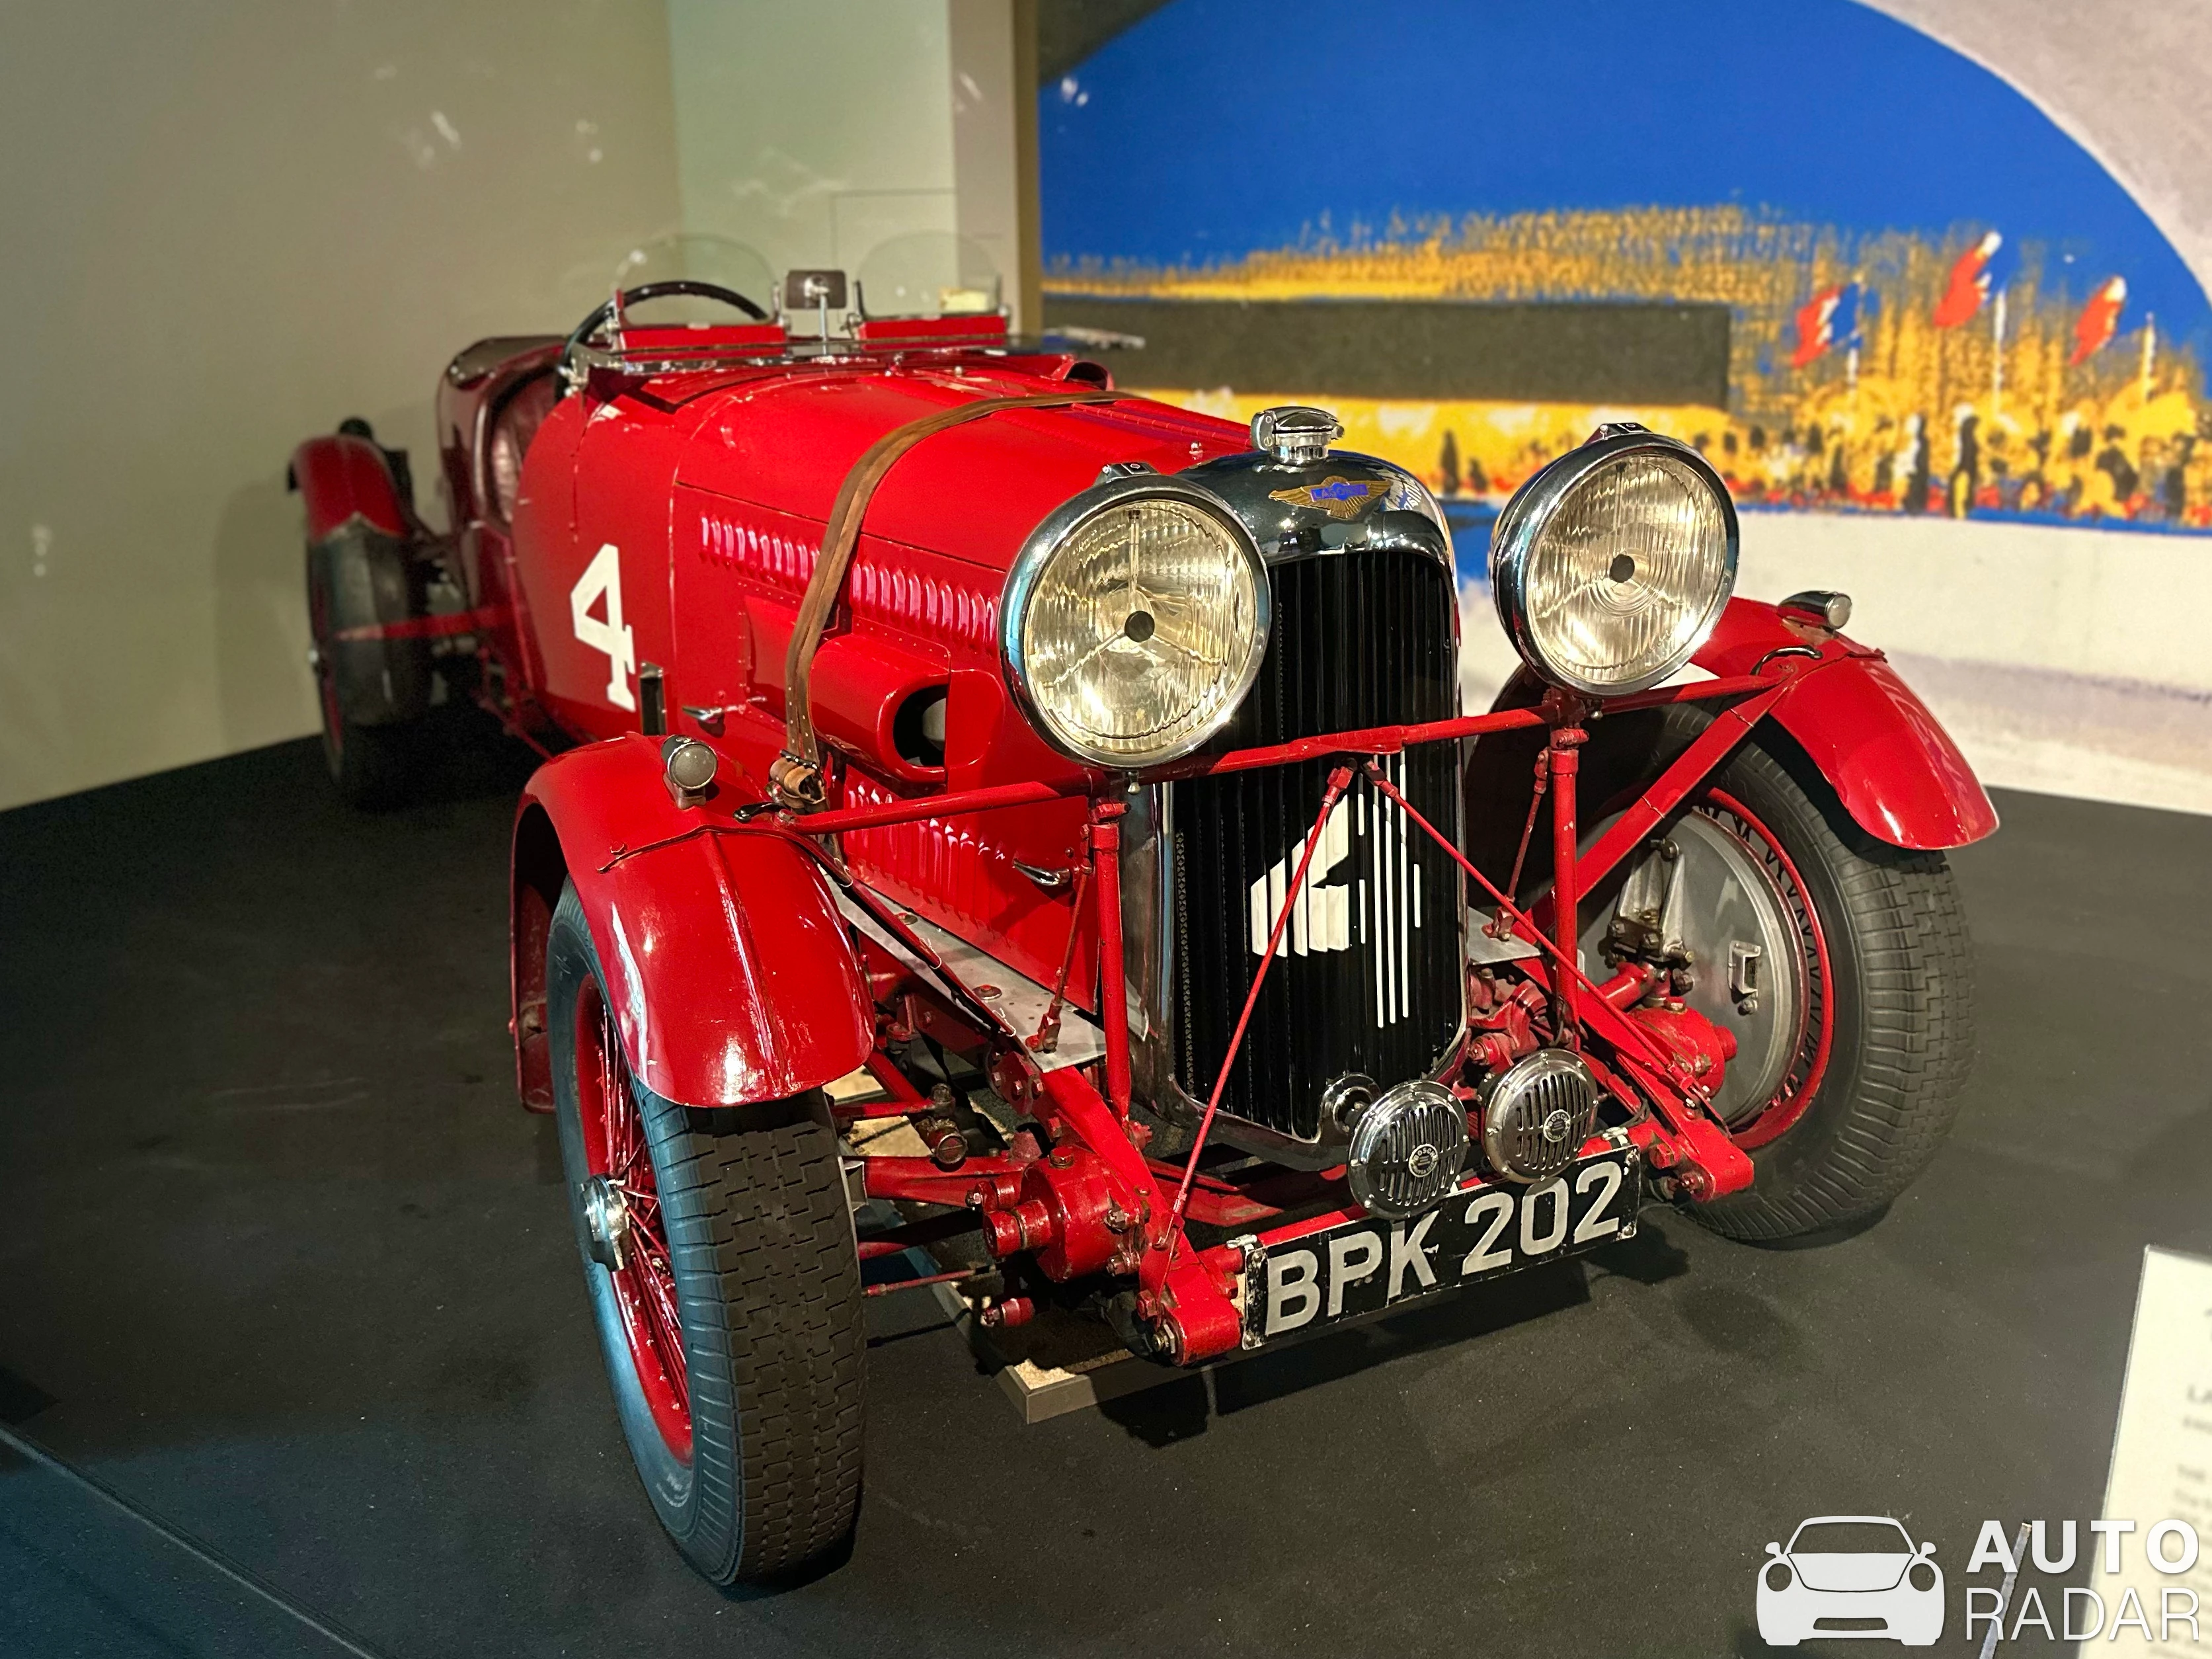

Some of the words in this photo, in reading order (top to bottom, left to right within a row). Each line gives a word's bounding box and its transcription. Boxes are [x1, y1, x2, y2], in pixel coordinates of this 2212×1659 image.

[570, 542, 636, 713] 4
[1251, 754, 1421, 1028] 4
[1413, 1147, 1435, 1161] BOSCH
[1548, 1113, 1567, 1127] BOSCH
[1265, 1209, 1440, 1336] BPK
[1462, 1160, 1623, 1276] 202
